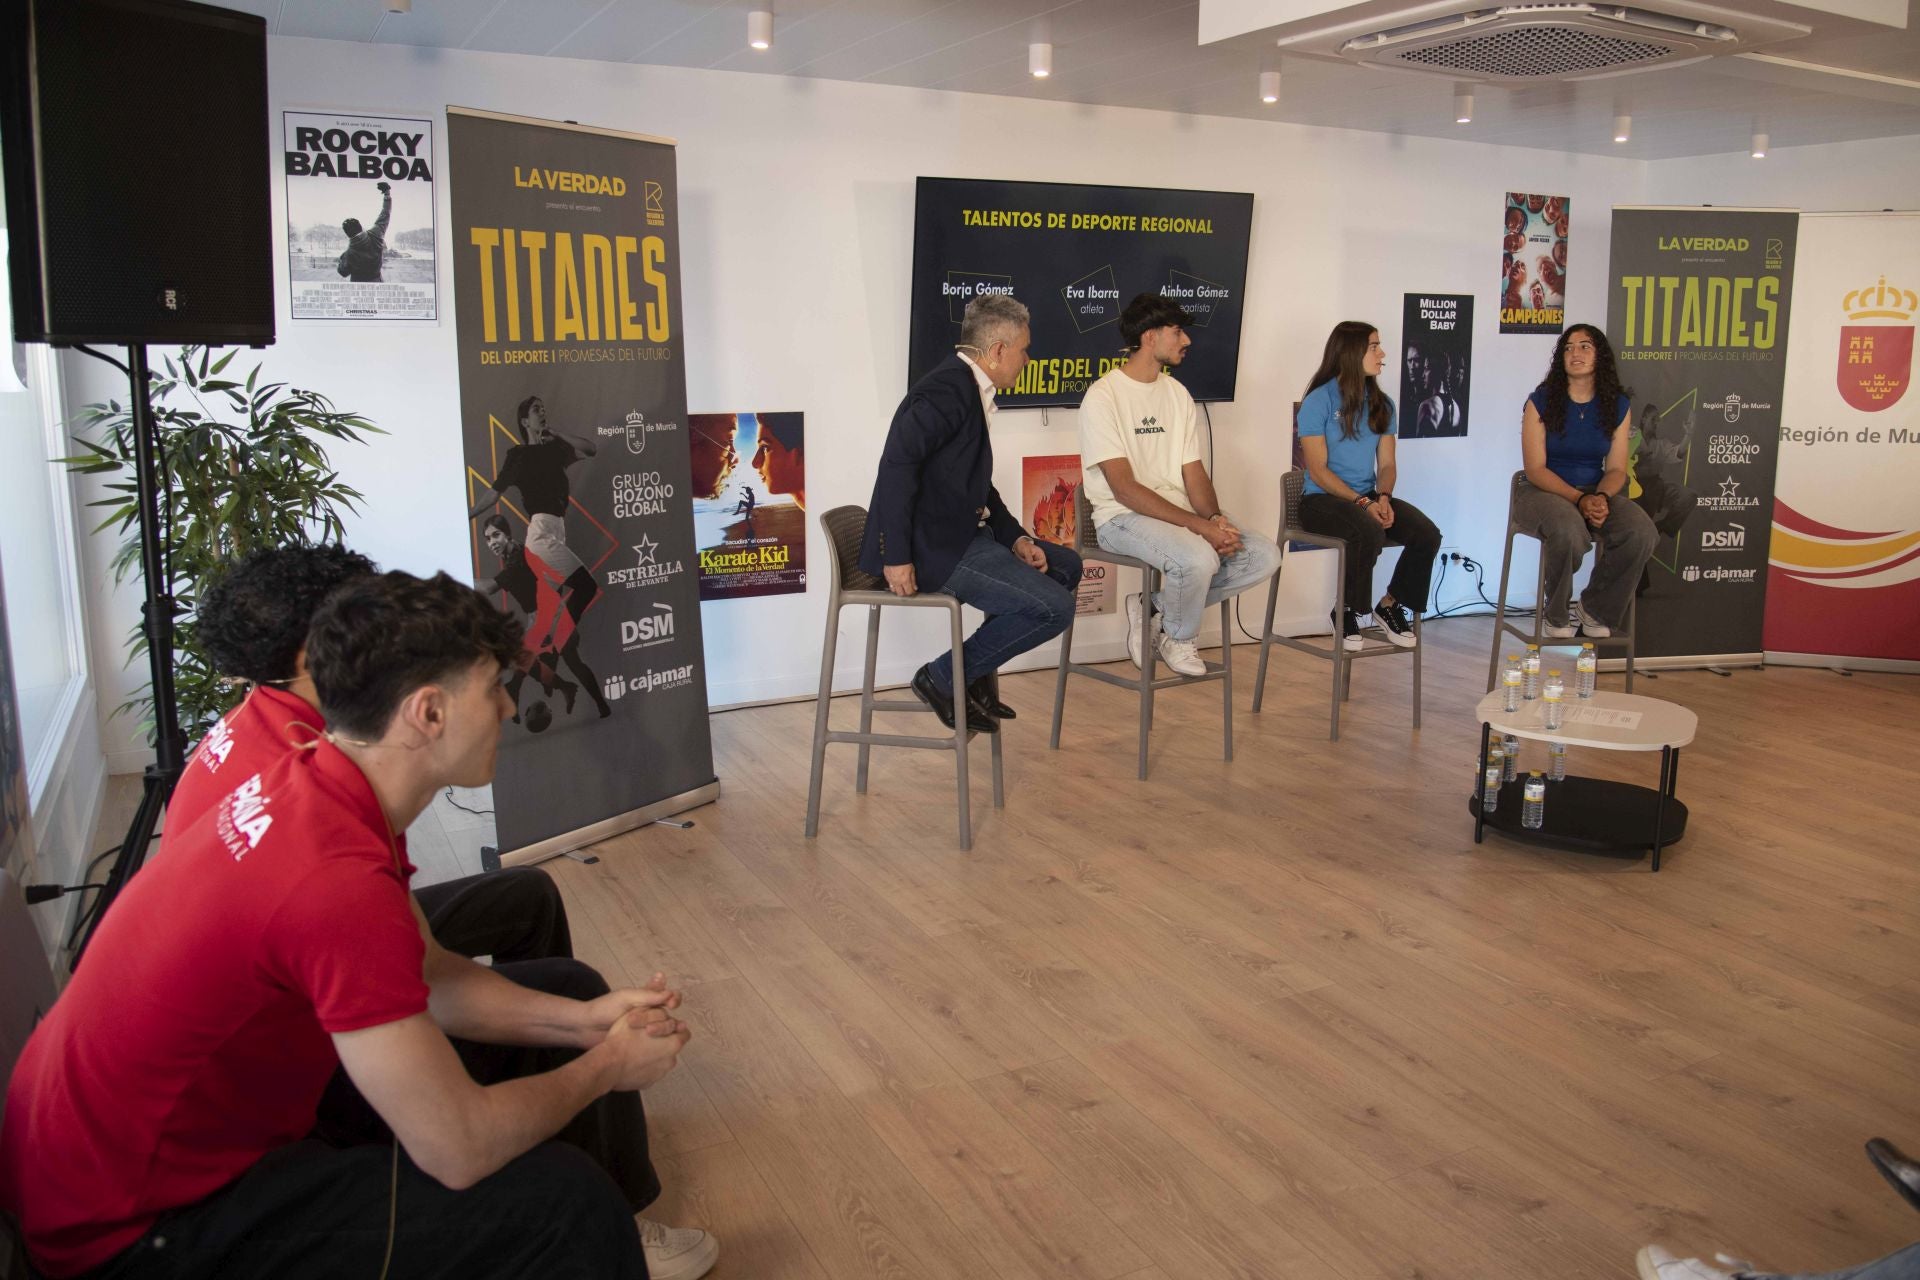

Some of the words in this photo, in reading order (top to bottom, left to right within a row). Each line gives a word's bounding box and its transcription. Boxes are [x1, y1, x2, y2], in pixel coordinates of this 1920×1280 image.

[296, 127, 424, 157] ROCKY
[284, 151, 433, 182] BALBOA
[514, 166, 544, 189] LA
[544, 169, 626, 197] VERDAD
[962, 209, 1042, 228] TALENTOS
[1047, 212, 1066, 229] DE
[1071, 213, 1136, 231] DEPORTE
[1141, 216, 1213, 234] REGIONAL
[1658, 236, 1681, 251] LA
[1682, 237, 1749, 252] VERDAD
[470, 227, 670, 343] TITANES
[942, 282, 972, 299] Borja
[975, 282, 1014, 296] Gómez
[1066, 285, 1085, 299] Eva
[1088, 286, 1120, 299] Ibarra
[1159, 285, 1194, 298] Ainhoa
[1196, 286, 1229, 298] Gómez
[165, 290, 176, 310] RCF
[1080, 303, 1104, 314] atleta
[1419, 298, 1457, 309] MILLION
[1180, 303, 1210, 315] egatista
[1420, 309, 1457, 320] DOLLAR
[1500, 308, 1563, 325] CAMPEONES
[1622, 275, 1780, 350] TITANES
[1429, 320, 1456, 330] BABY
[480, 350, 502, 365] DEL
[504, 350, 549, 364] DEPORTE
[558, 349, 616, 363] PROMESAS
[618, 348, 635, 361] DEL
[637, 347, 671, 361] FUTURO
[1621, 351, 1636, 360] DEL
[1638, 351, 1672, 361] DEPORTE
[1679, 351, 1724, 361] PROMESAS
[1726, 351, 1740, 361] DEL
[1742, 351, 1774, 361] FUTURO
[1062, 358, 1093, 379] DEL
[1703, 402, 1724, 410] Región
[597, 425, 624, 437] Región
[645, 424, 654, 432] de
[655, 422, 677, 432] Murcia
[1135, 426, 1166, 435] HONDA
[1779, 426, 1849, 446] Región
[1856, 427, 1881, 443] de
[1709, 434, 1750, 445] GRUPO
[1708, 444, 1760, 455] HOZONO
[1708, 454, 1751, 464] GLOBAL
[612, 471, 660, 489] GRUPO
[613, 484, 674, 504] HOZONO
[1696, 496, 1760, 507] ESTRELLA
[613, 499, 667, 518] GLOBAL
[1701, 531, 1745, 547] DSM
[699, 549, 758, 568] Karate
[759, 545, 789, 564] Kid
[607, 560, 684, 585] ESTRELLA
[705, 567, 714, 575] El
[715, 564, 744, 574] Momento
[746, 564, 755, 572] de
[763, 562, 785, 571] Verdad
[1703, 565, 1757, 582] cajamar
[626, 580, 636, 589] DE
[637, 575, 669, 588] LEVANTE
[621, 612, 675, 645] DSM
[630, 664, 694, 693] cajamar
